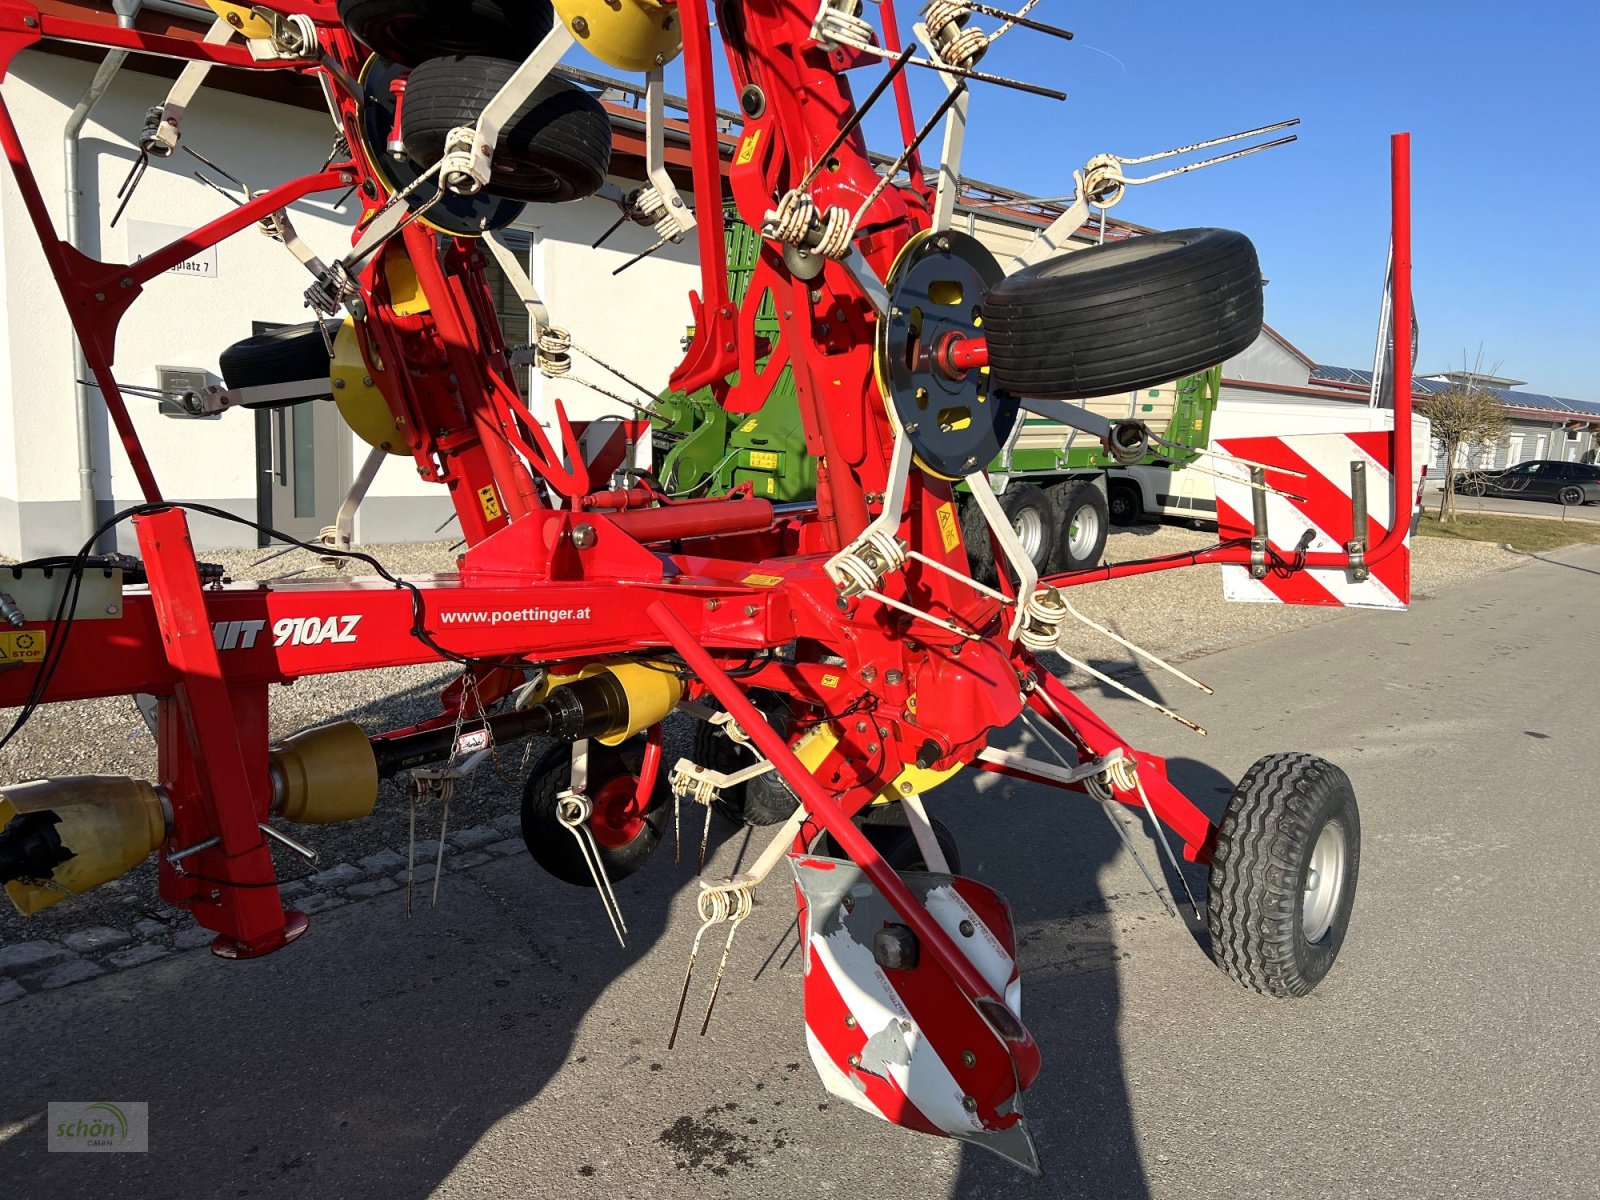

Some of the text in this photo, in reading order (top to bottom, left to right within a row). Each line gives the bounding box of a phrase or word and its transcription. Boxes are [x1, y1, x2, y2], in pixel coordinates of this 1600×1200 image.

[204, 262, 209, 272] 7
[440, 607, 591, 625] www.poettinger.at
[272, 614, 363, 647] 910AZ
[12, 650, 40, 658] STOP
